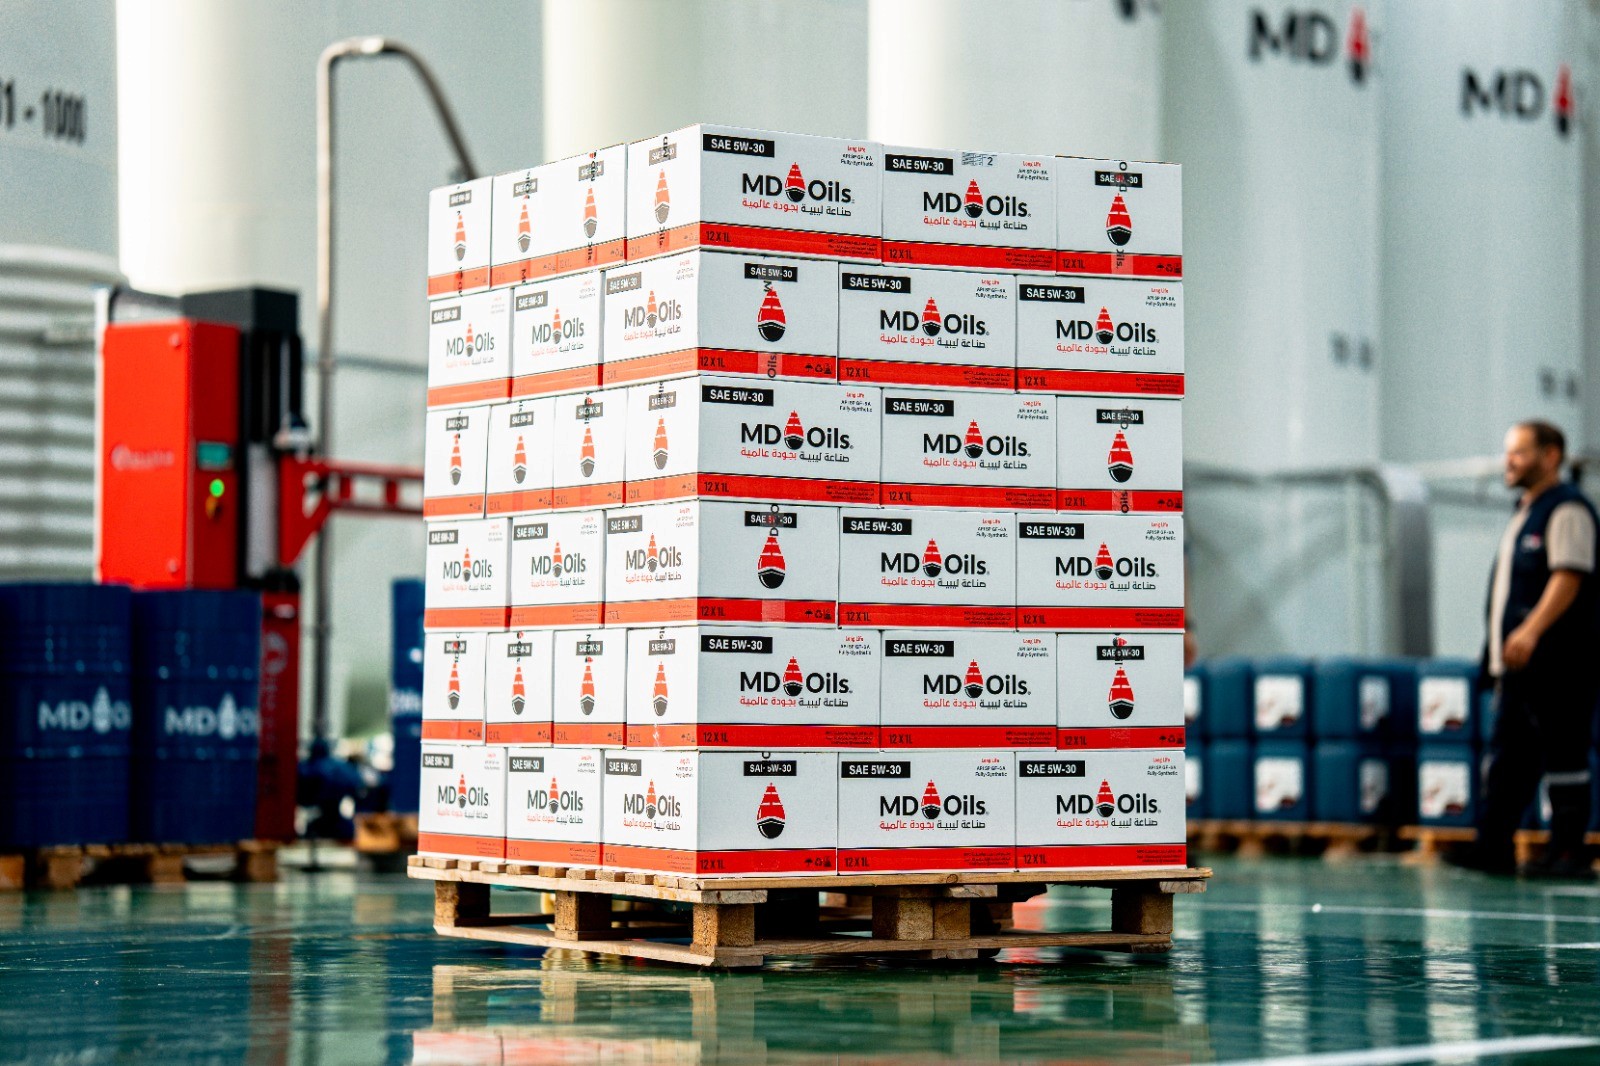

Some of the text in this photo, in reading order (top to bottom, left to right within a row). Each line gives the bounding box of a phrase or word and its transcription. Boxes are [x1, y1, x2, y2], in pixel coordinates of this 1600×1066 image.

[1248, 10, 1340, 66] MD
[1459, 67, 1545, 120] MD
[711, 140, 765, 154] SAE 5W-30
[893, 160, 944, 172] SAE 5W-30
[1100, 174, 1114, 182] SAE
[743, 174, 851, 203] MD Oils
[924, 192, 1027, 217] MD Oils
[750, 267, 793, 278] SAE 5W-30
[610, 281, 620, 291] SAE
[850, 278, 901, 290] SAE 5W-30
[1027, 289, 1076, 300] SAE 5W-30
[625, 298, 681, 328] MD Oils
[881, 310, 985, 336] MD Oils
[532, 316, 584, 344] MD Oils
[1057, 320, 1156, 343] MD Oils
[447, 331, 494, 356] MD Oils
[710, 391, 763, 403] SAE 5W-30
[893, 403, 944, 413] SAE 5W-30
[1102, 412, 1116, 420] SAE
[742, 423, 850, 449] MD Oils
[924, 433, 1027, 457] MD Oils
[750, 514, 766, 523] SAE
[851, 522, 902, 532] SAE 5W-30
[1026, 527, 1075, 536] SAE 5W-30
[532, 552, 586, 575] MD Oils
[626, 546, 681, 569] MD Oils
[882, 553, 986, 575] MD Oils
[1056, 557, 1155, 577] MD Oils
[444, 559, 492, 578] MD Oils
[709, 640, 762, 650] SAE 5W-30
[893, 645, 944, 654] SAE 5W-30
[741, 672, 849, 694] MD Oils
[924, 675, 1027, 695] MD Oils
[38, 700, 90, 730] MD
[164, 706, 217, 735] MD
[513, 761, 539, 770] SAE 5W-30
[609, 763, 619, 772] SAE
[849, 765, 901, 775] SAE 5W-30
[1027, 765, 1076, 774] SAE 5W-30
[438, 785, 488, 807] MD Oils
[528, 790, 583, 811] MD Oils
[624, 794, 680, 817] MD Oils
[880, 795, 985, 816] MD Oils
[1057, 793, 1157, 814] MD Oils
